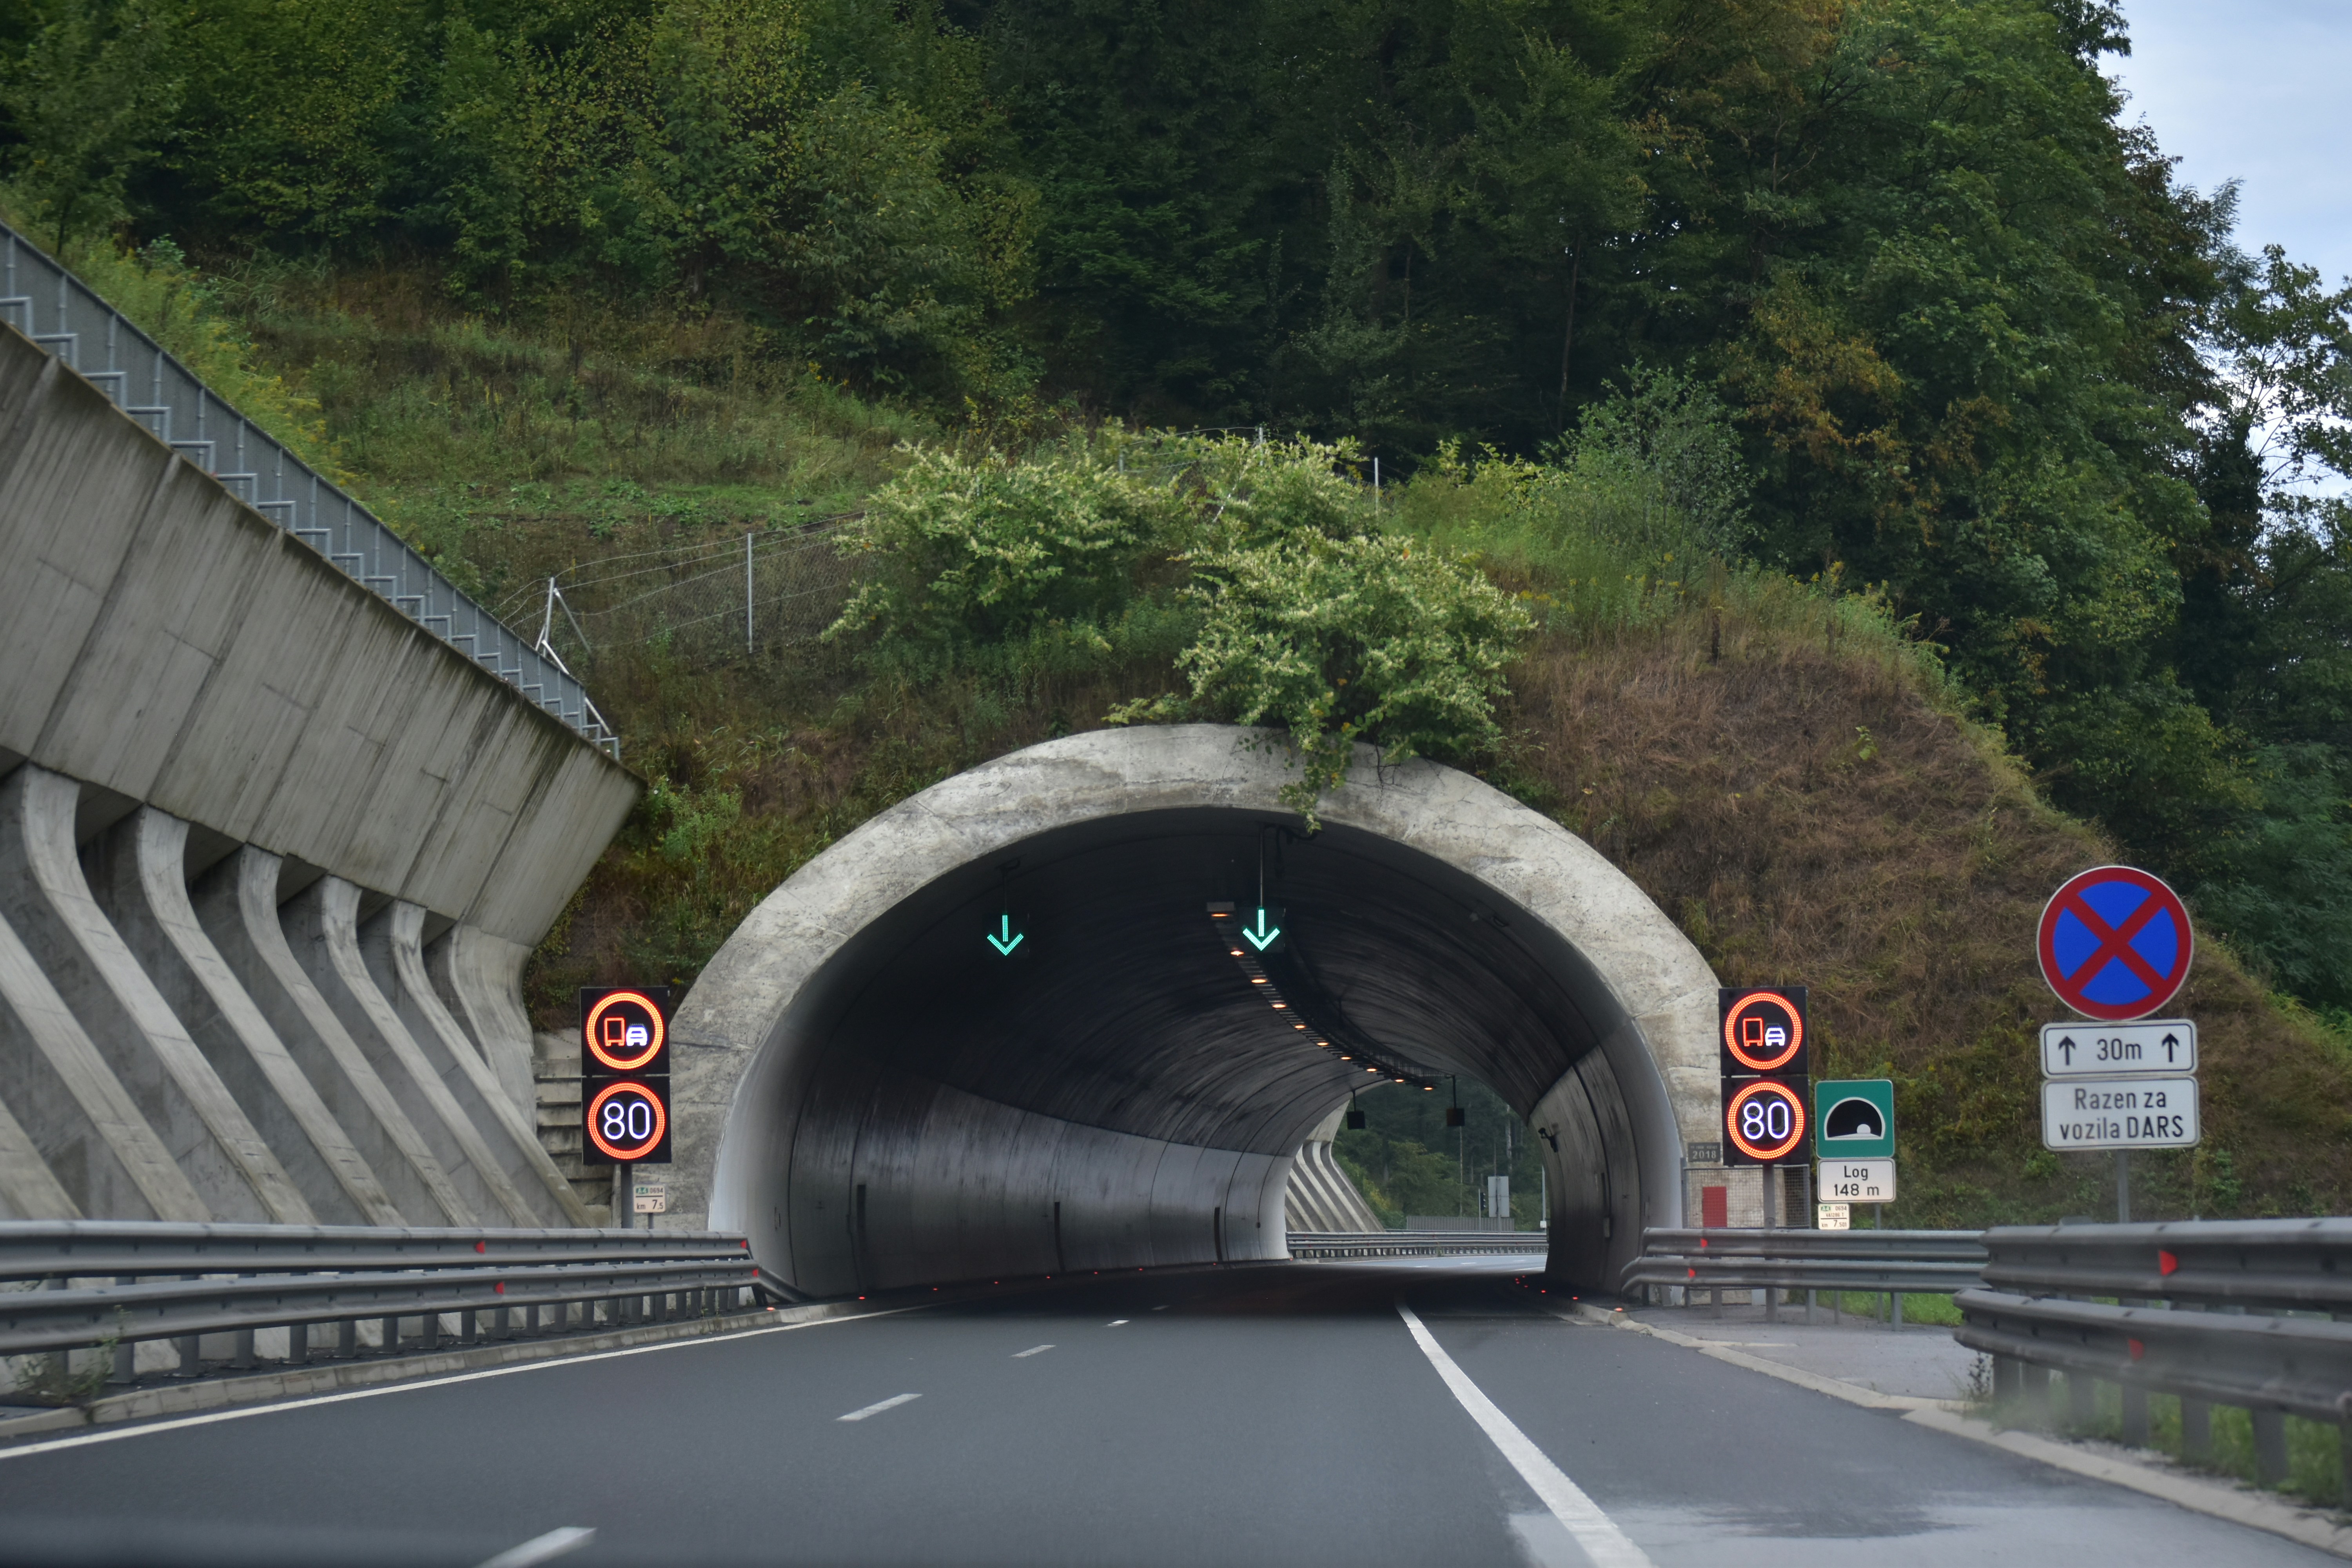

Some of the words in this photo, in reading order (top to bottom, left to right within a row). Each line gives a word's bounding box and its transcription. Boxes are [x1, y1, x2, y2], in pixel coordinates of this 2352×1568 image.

[2097, 1038, 2142, 1061] 30m
[2074, 1088, 2136, 1109] Razen
[2143, 1092, 2166, 1108] za
[604, 1102, 650, 1140] 80
[1744, 1102, 1789, 1140] 80
[2060, 1117, 2120, 1140] vozila
[2126, 1115, 2183, 1138] DARS
[1693, 1150, 1716, 1159] 2018
[1844, 1165, 1868, 1181] Log
[1834, 1183, 1859, 1196] 148
[1867, 1186, 1879, 1196] m
